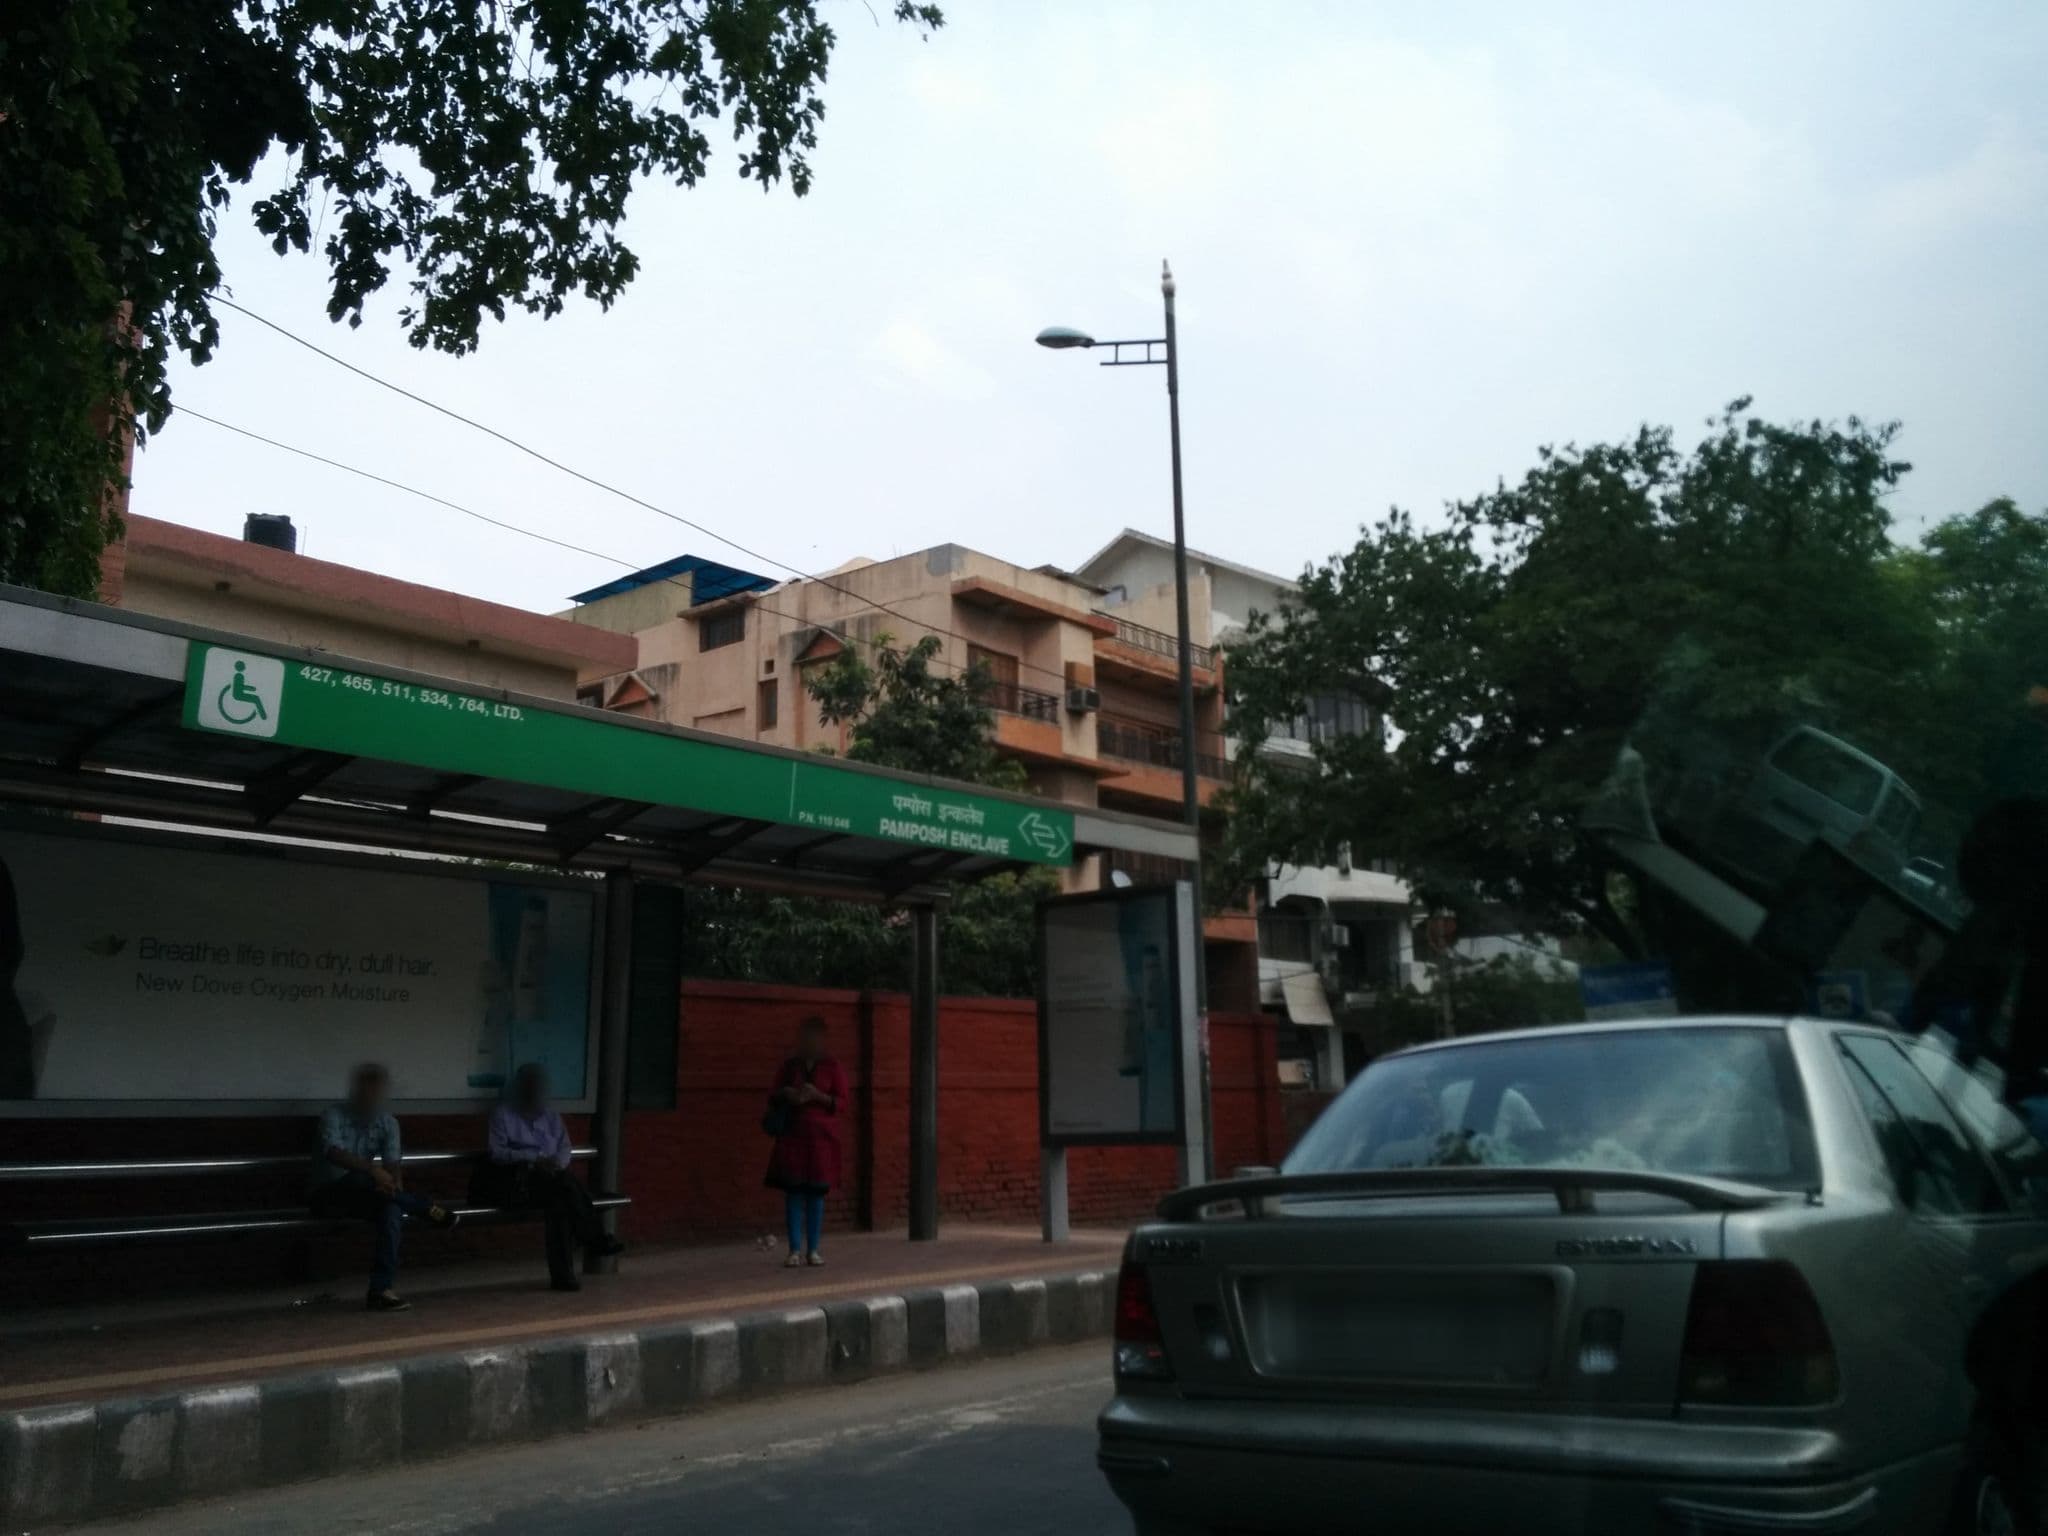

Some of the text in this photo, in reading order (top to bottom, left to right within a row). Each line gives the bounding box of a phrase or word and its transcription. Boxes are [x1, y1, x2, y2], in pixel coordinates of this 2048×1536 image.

[300, 665, 524, 721] 427, 465, 511, 534, 764, LTD.
[879, 817, 1009, 855] PAMPOSH ENCLAVE
[139, 936, 437, 977] Breathe life into dry, dull hair.
[135, 971, 409, 1002] New Dove Oxygen Moisture
